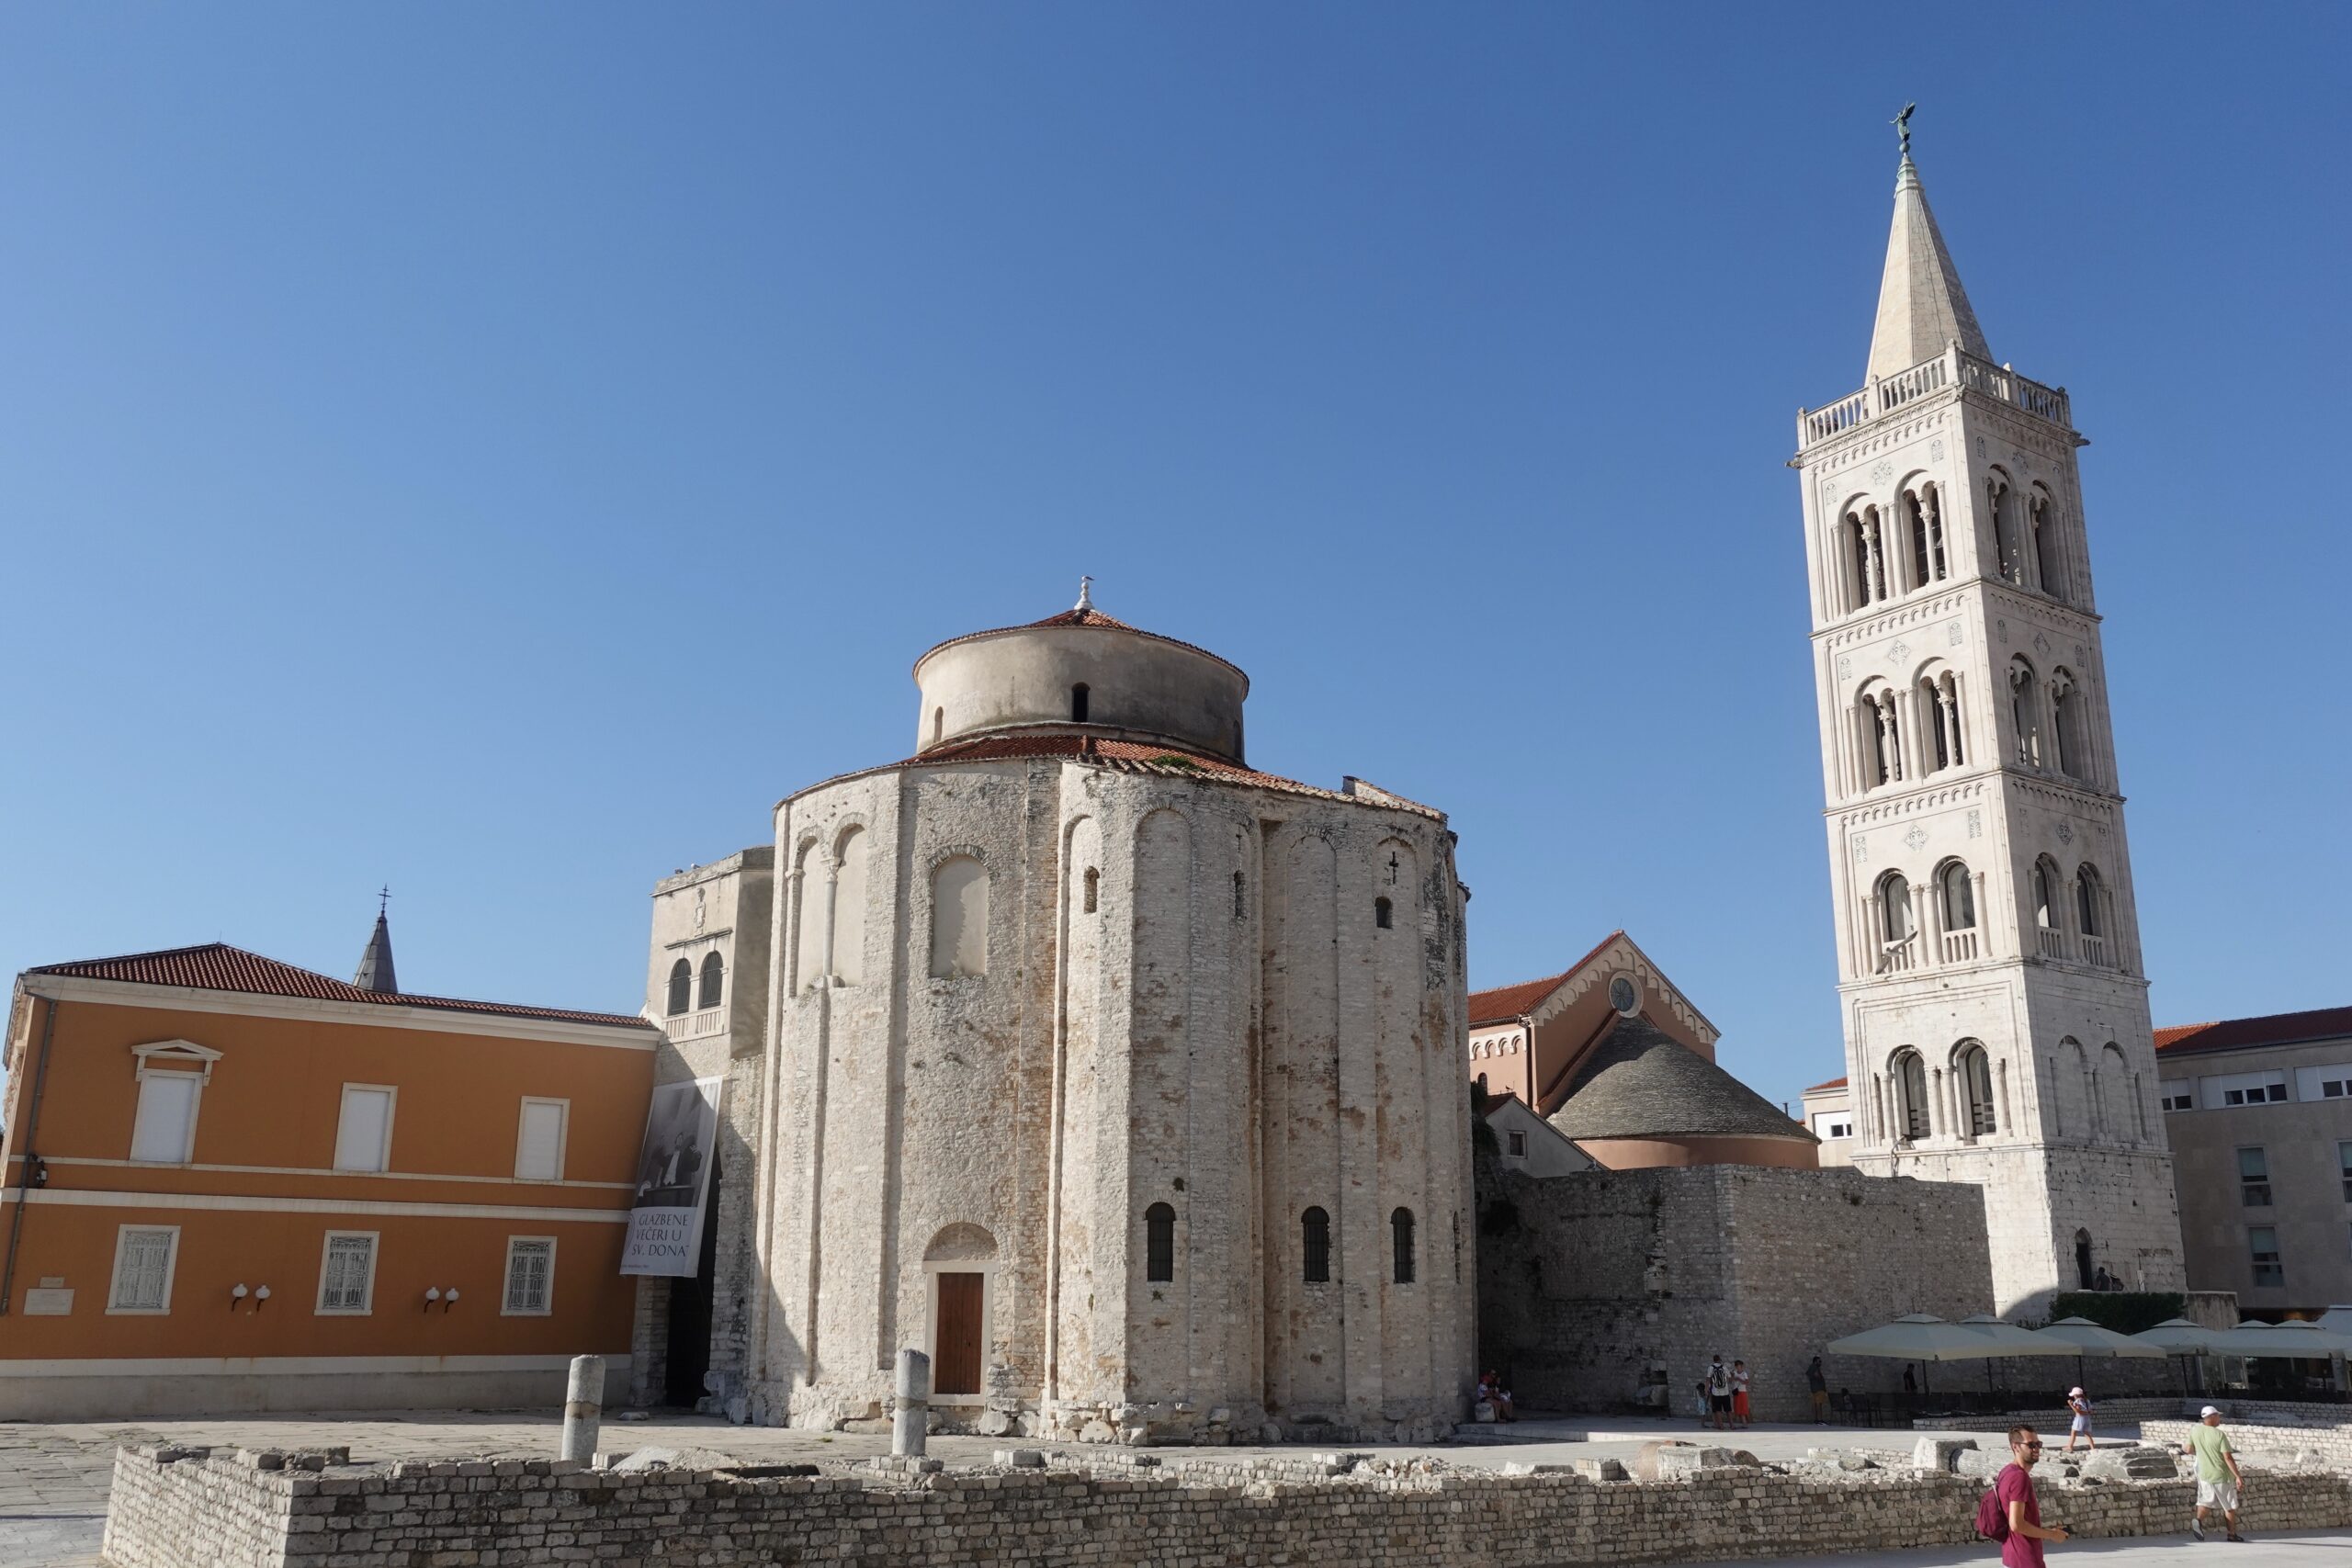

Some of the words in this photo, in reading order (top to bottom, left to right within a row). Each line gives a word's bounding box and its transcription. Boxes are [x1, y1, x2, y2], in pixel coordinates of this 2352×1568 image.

[639, 1213, 689, 1226] GLAZBENE
[636, 1227, 668, 1241] VEČERI
[672, 1229, 682, 1242] U
[631, 1244, 645, 1257] SV.
